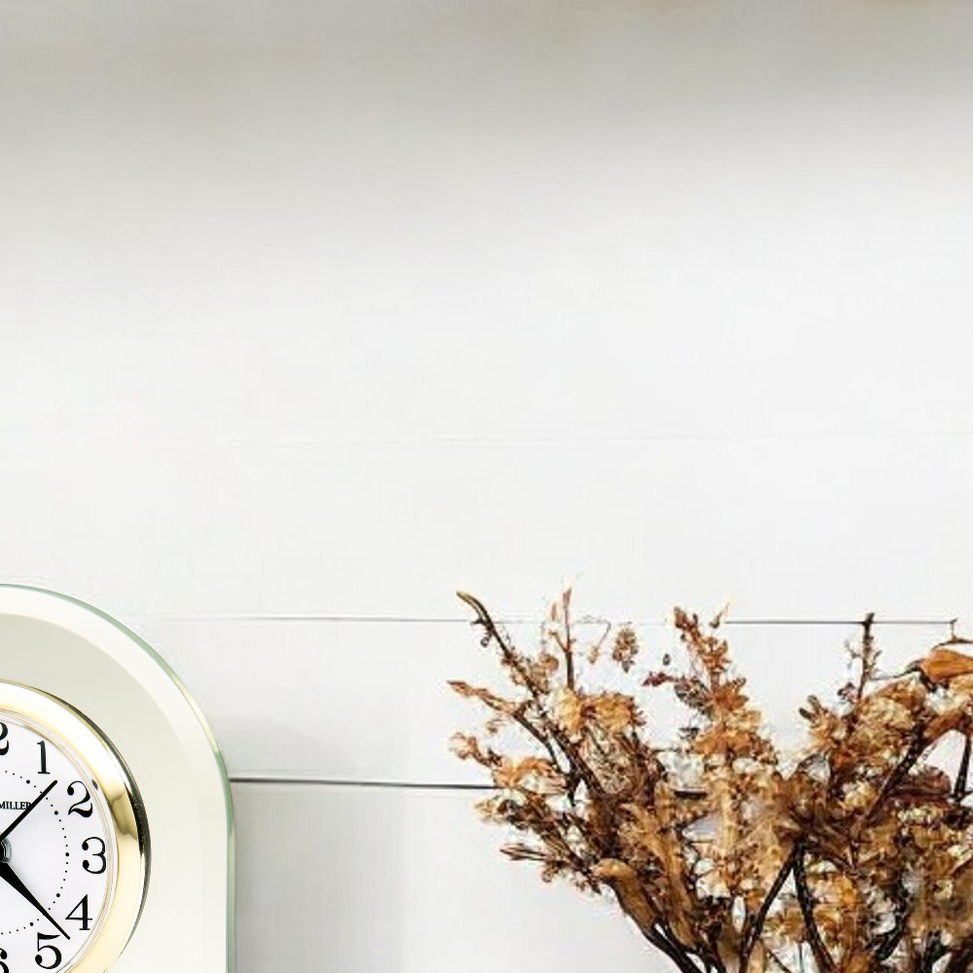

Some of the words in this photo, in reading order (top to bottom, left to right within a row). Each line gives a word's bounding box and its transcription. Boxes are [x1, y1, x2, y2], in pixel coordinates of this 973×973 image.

[36, 740, 51, 775] 1
[66, 780, 94, 818] 2
[81, 836, 107, 875] 3
[64, 894, 93, 931] 4
[34, 931, 62, 970] 5
